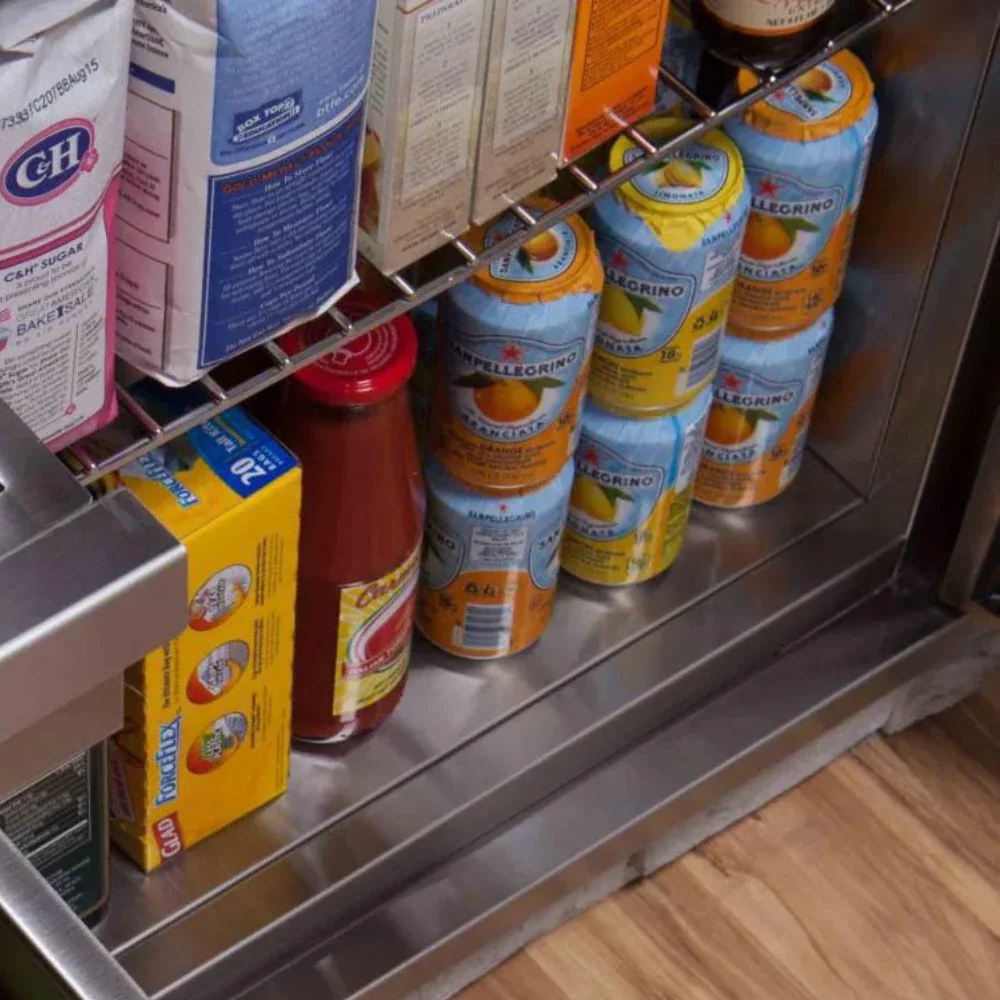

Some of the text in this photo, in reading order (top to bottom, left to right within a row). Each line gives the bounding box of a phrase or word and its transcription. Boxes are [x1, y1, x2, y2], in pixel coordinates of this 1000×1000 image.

[41, 242, 85, 269] SUGAR
[17, 309, 58, 336] BAKE
[230, 456, 267, 486] 20
[153, 710, 182, 807] FORCEFLEX
[159, 819, 182, 860] GLAD
